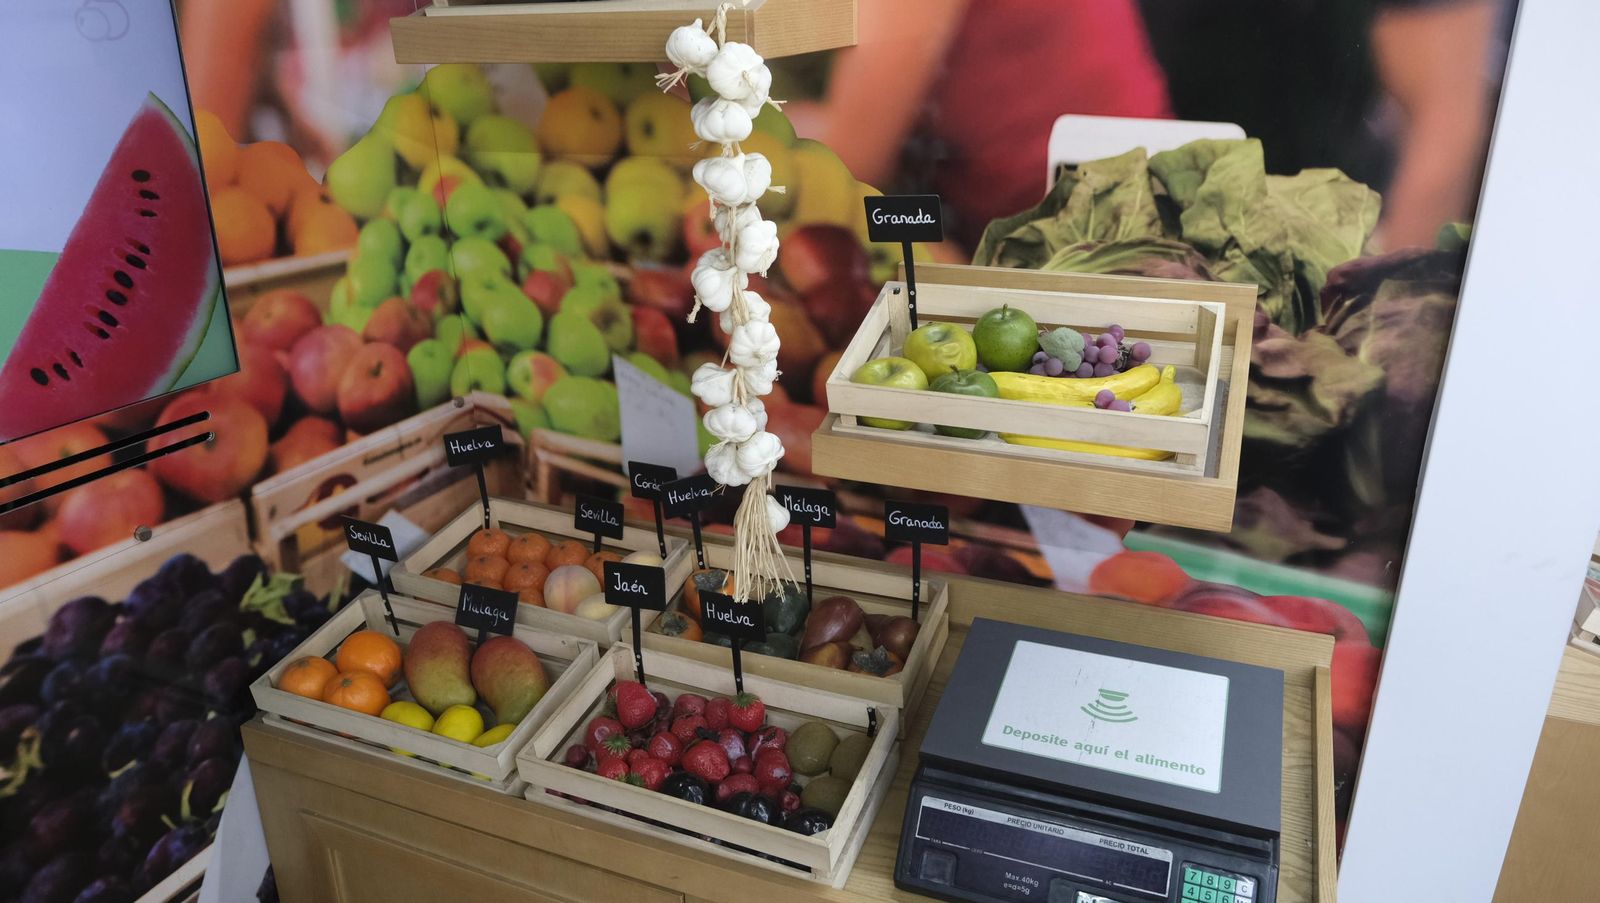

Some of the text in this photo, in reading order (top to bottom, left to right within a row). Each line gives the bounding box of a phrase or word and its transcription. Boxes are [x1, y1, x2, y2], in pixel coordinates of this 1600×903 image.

[872, 208, 936, 225] Granada
[450, 438, 495, 455] Huelva
[634, 473, 662, 491] Córd
[668, 488, 712, 505] Huelva
[580, 503, 620, 527] Sevilla
[783, 494, 831, 521] Málaga
[888, 510, 945, 530] Granada
[349, 524, 391, 548] Sevilla
[613, 572, 648, 596] Jaén
[706, 602, 755, 628] Huelva
[1002, 725, 1206, 776] Deposite aquí el alimento
[944, 802, 975, 815] PESO (kg)
[1007, 817, 1065, 836] PRECIO UNITARIO
[1099, 838, 1150, 855] PRECIO TOTAL
[1190, 871, 1248, 893] 7 8 9 C
[1187, 886, 1194, 896] 4
[1204, 890, 1212, 901] 5
